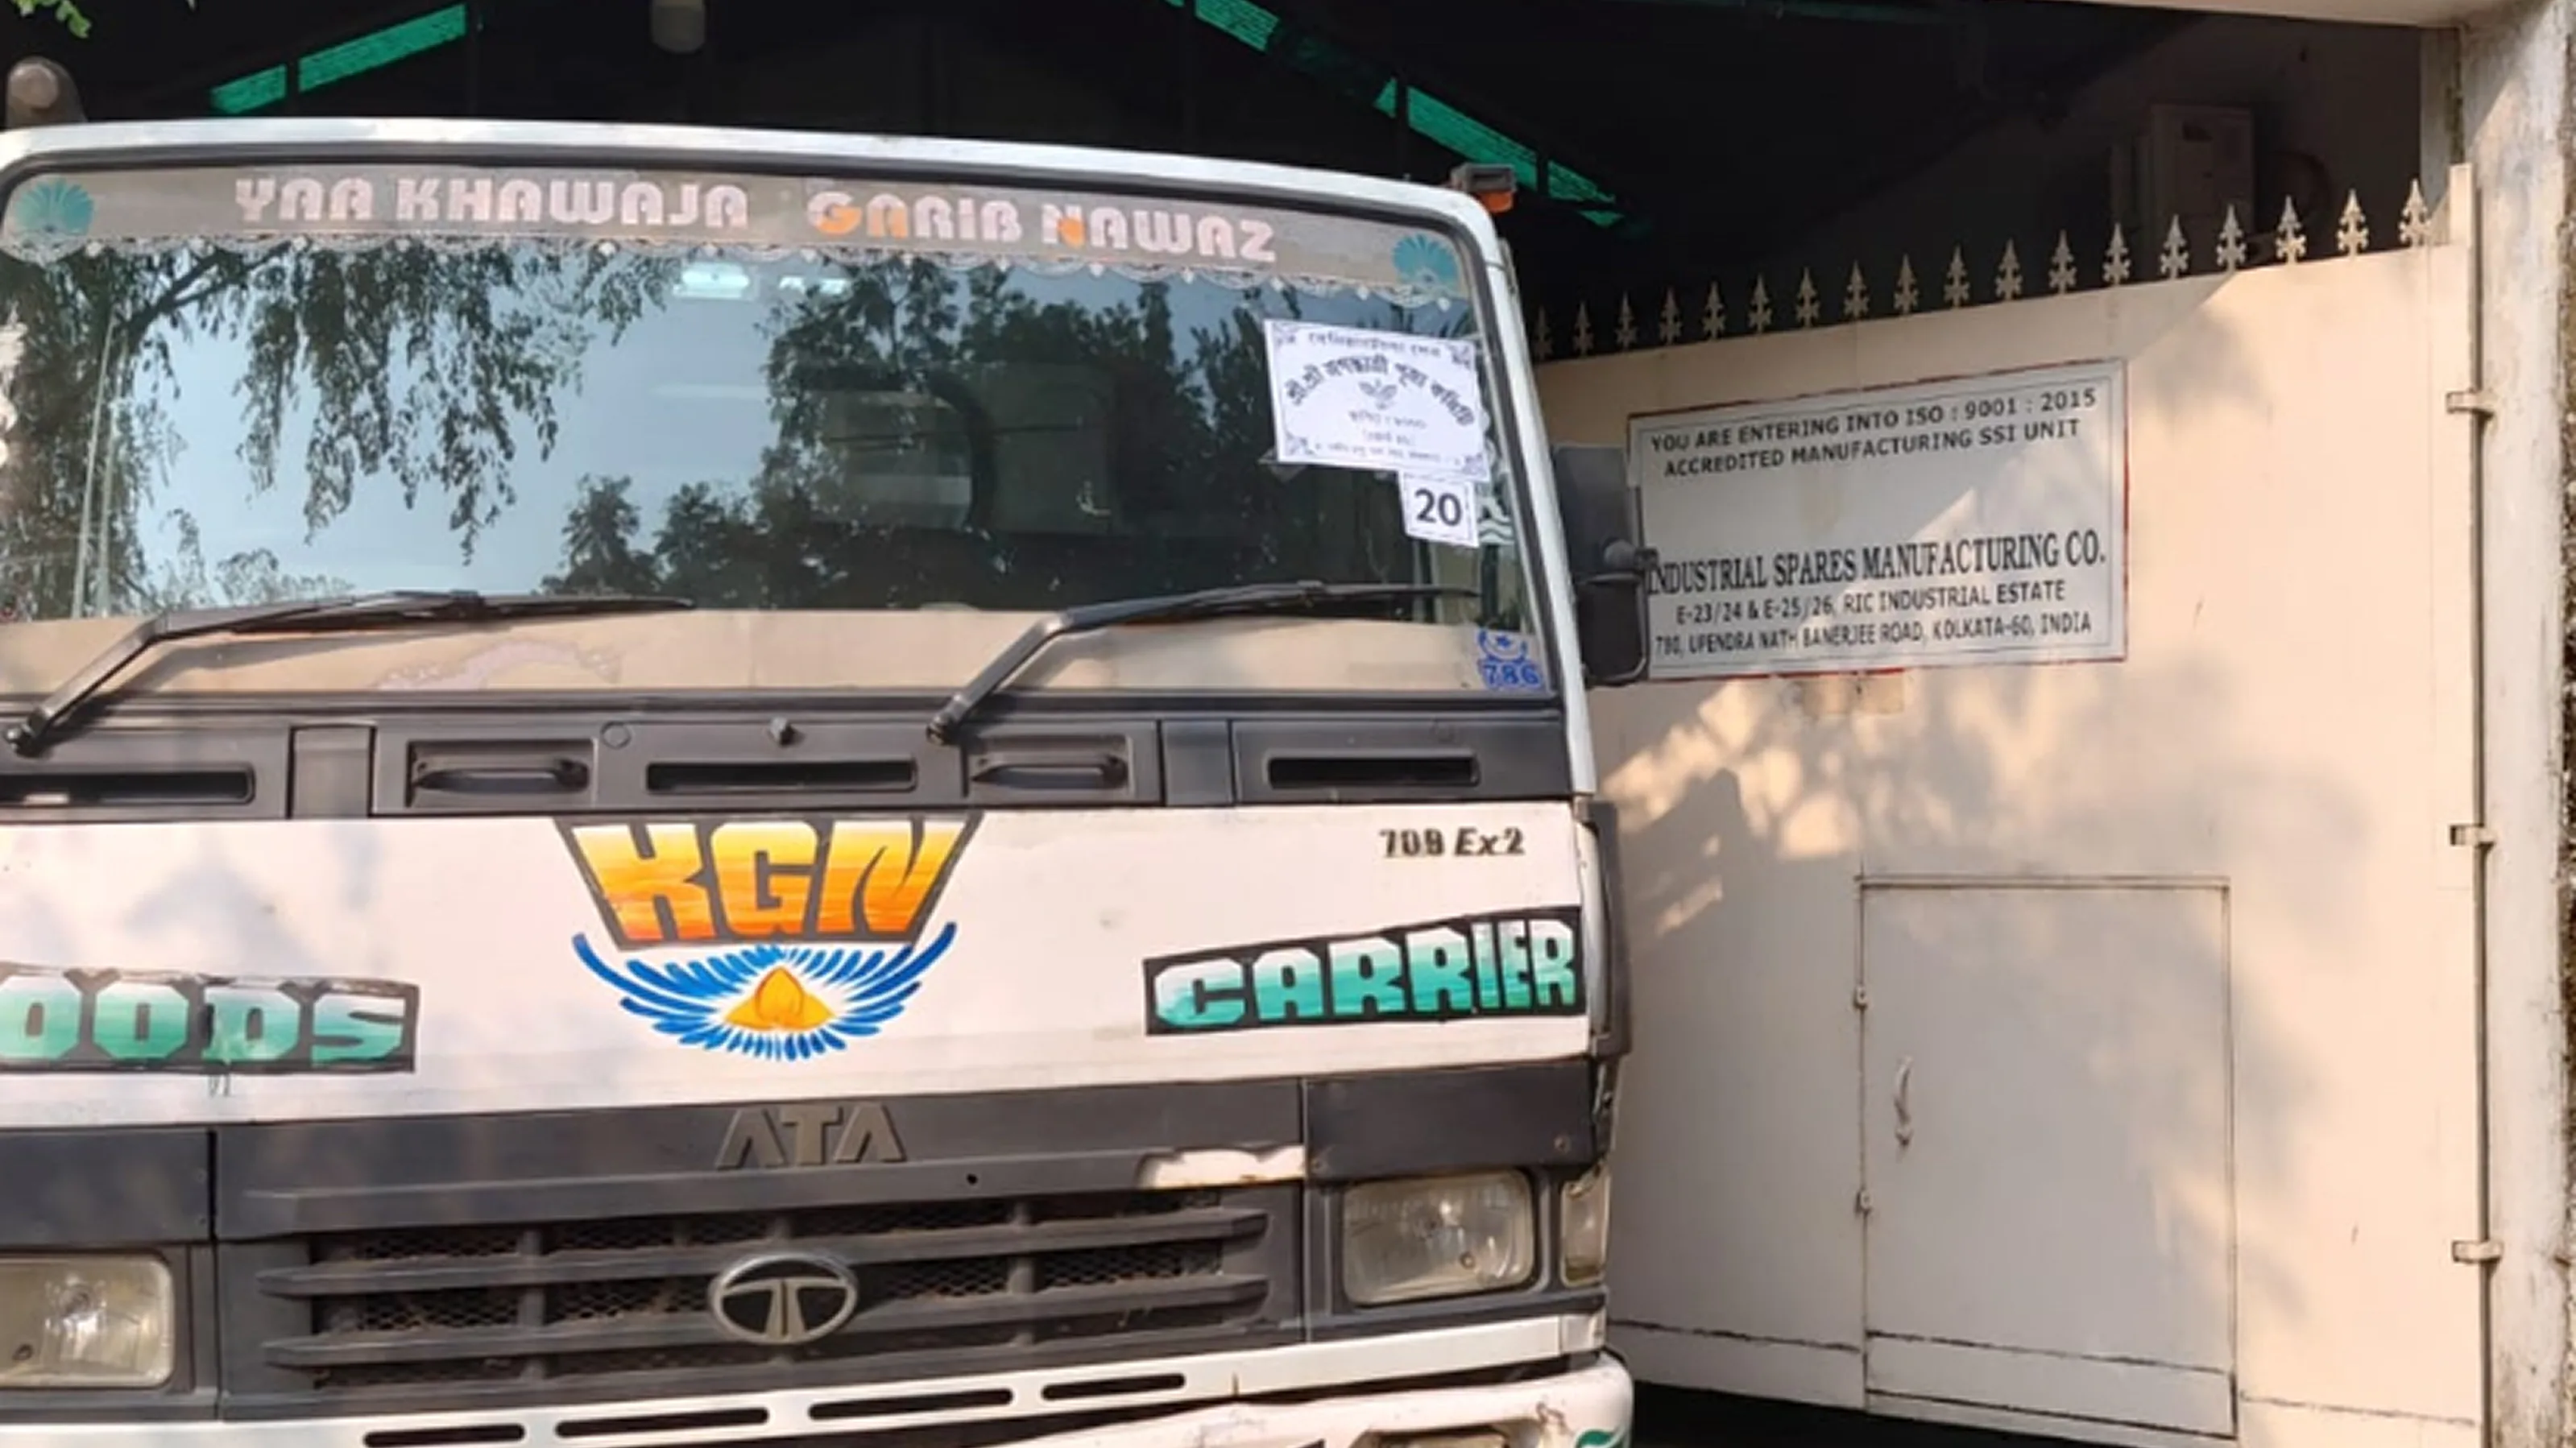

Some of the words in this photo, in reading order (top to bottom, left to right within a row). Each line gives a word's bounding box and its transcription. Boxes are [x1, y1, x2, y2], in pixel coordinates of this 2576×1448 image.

[235, 177, 374, 221] YAA
[396, 177, 749, 228] KHAWAJA
[1042, 204, 1277, 263] NAWAZ
[1651, 432, 1689, 452] YOU
[1695, 428, 1732, 448] ARE
[1738, 416, 1840, 443] ENTERING
[1846, 411, 1899, 432] INTO
[1905, 405, 1944, 425] ISO
[1965, 399, 2017, 420] 9001
[2040, 388, 2097, 412] 2015
[1664, 449, 1785, 477] ACCREDITED
[1791, 428, 1973, 464] MANUFACTURING
[1979, 423, 2017, 445] SSI
[2023, 418, 2080, 441] UNIT
[1414, 488, 1462, 526] 20
[1773, 548, 1857, 587] SPARES
[1862, 532, 2060, 579] MANUFACTURING
[2065, 528, 2106, 565] CO.
[1748, 600, 1758, 621] &
[1843, 592, 1874, 614] RIC
[1880, 585, 1991, 612] INDUSTRIAL
[1997, 579, 2065, 604] ESTATE
[1759, 628, 1797, 649] NATH
[1803, 623, 1875, 647] BANERJEE
[2040, 611, 2092, 634] INDIA
[1483, 663, 1540, 685] 786
[571, 821, 967, 941] KGN
[1155, 919, 1576, 1029] CARRIER
